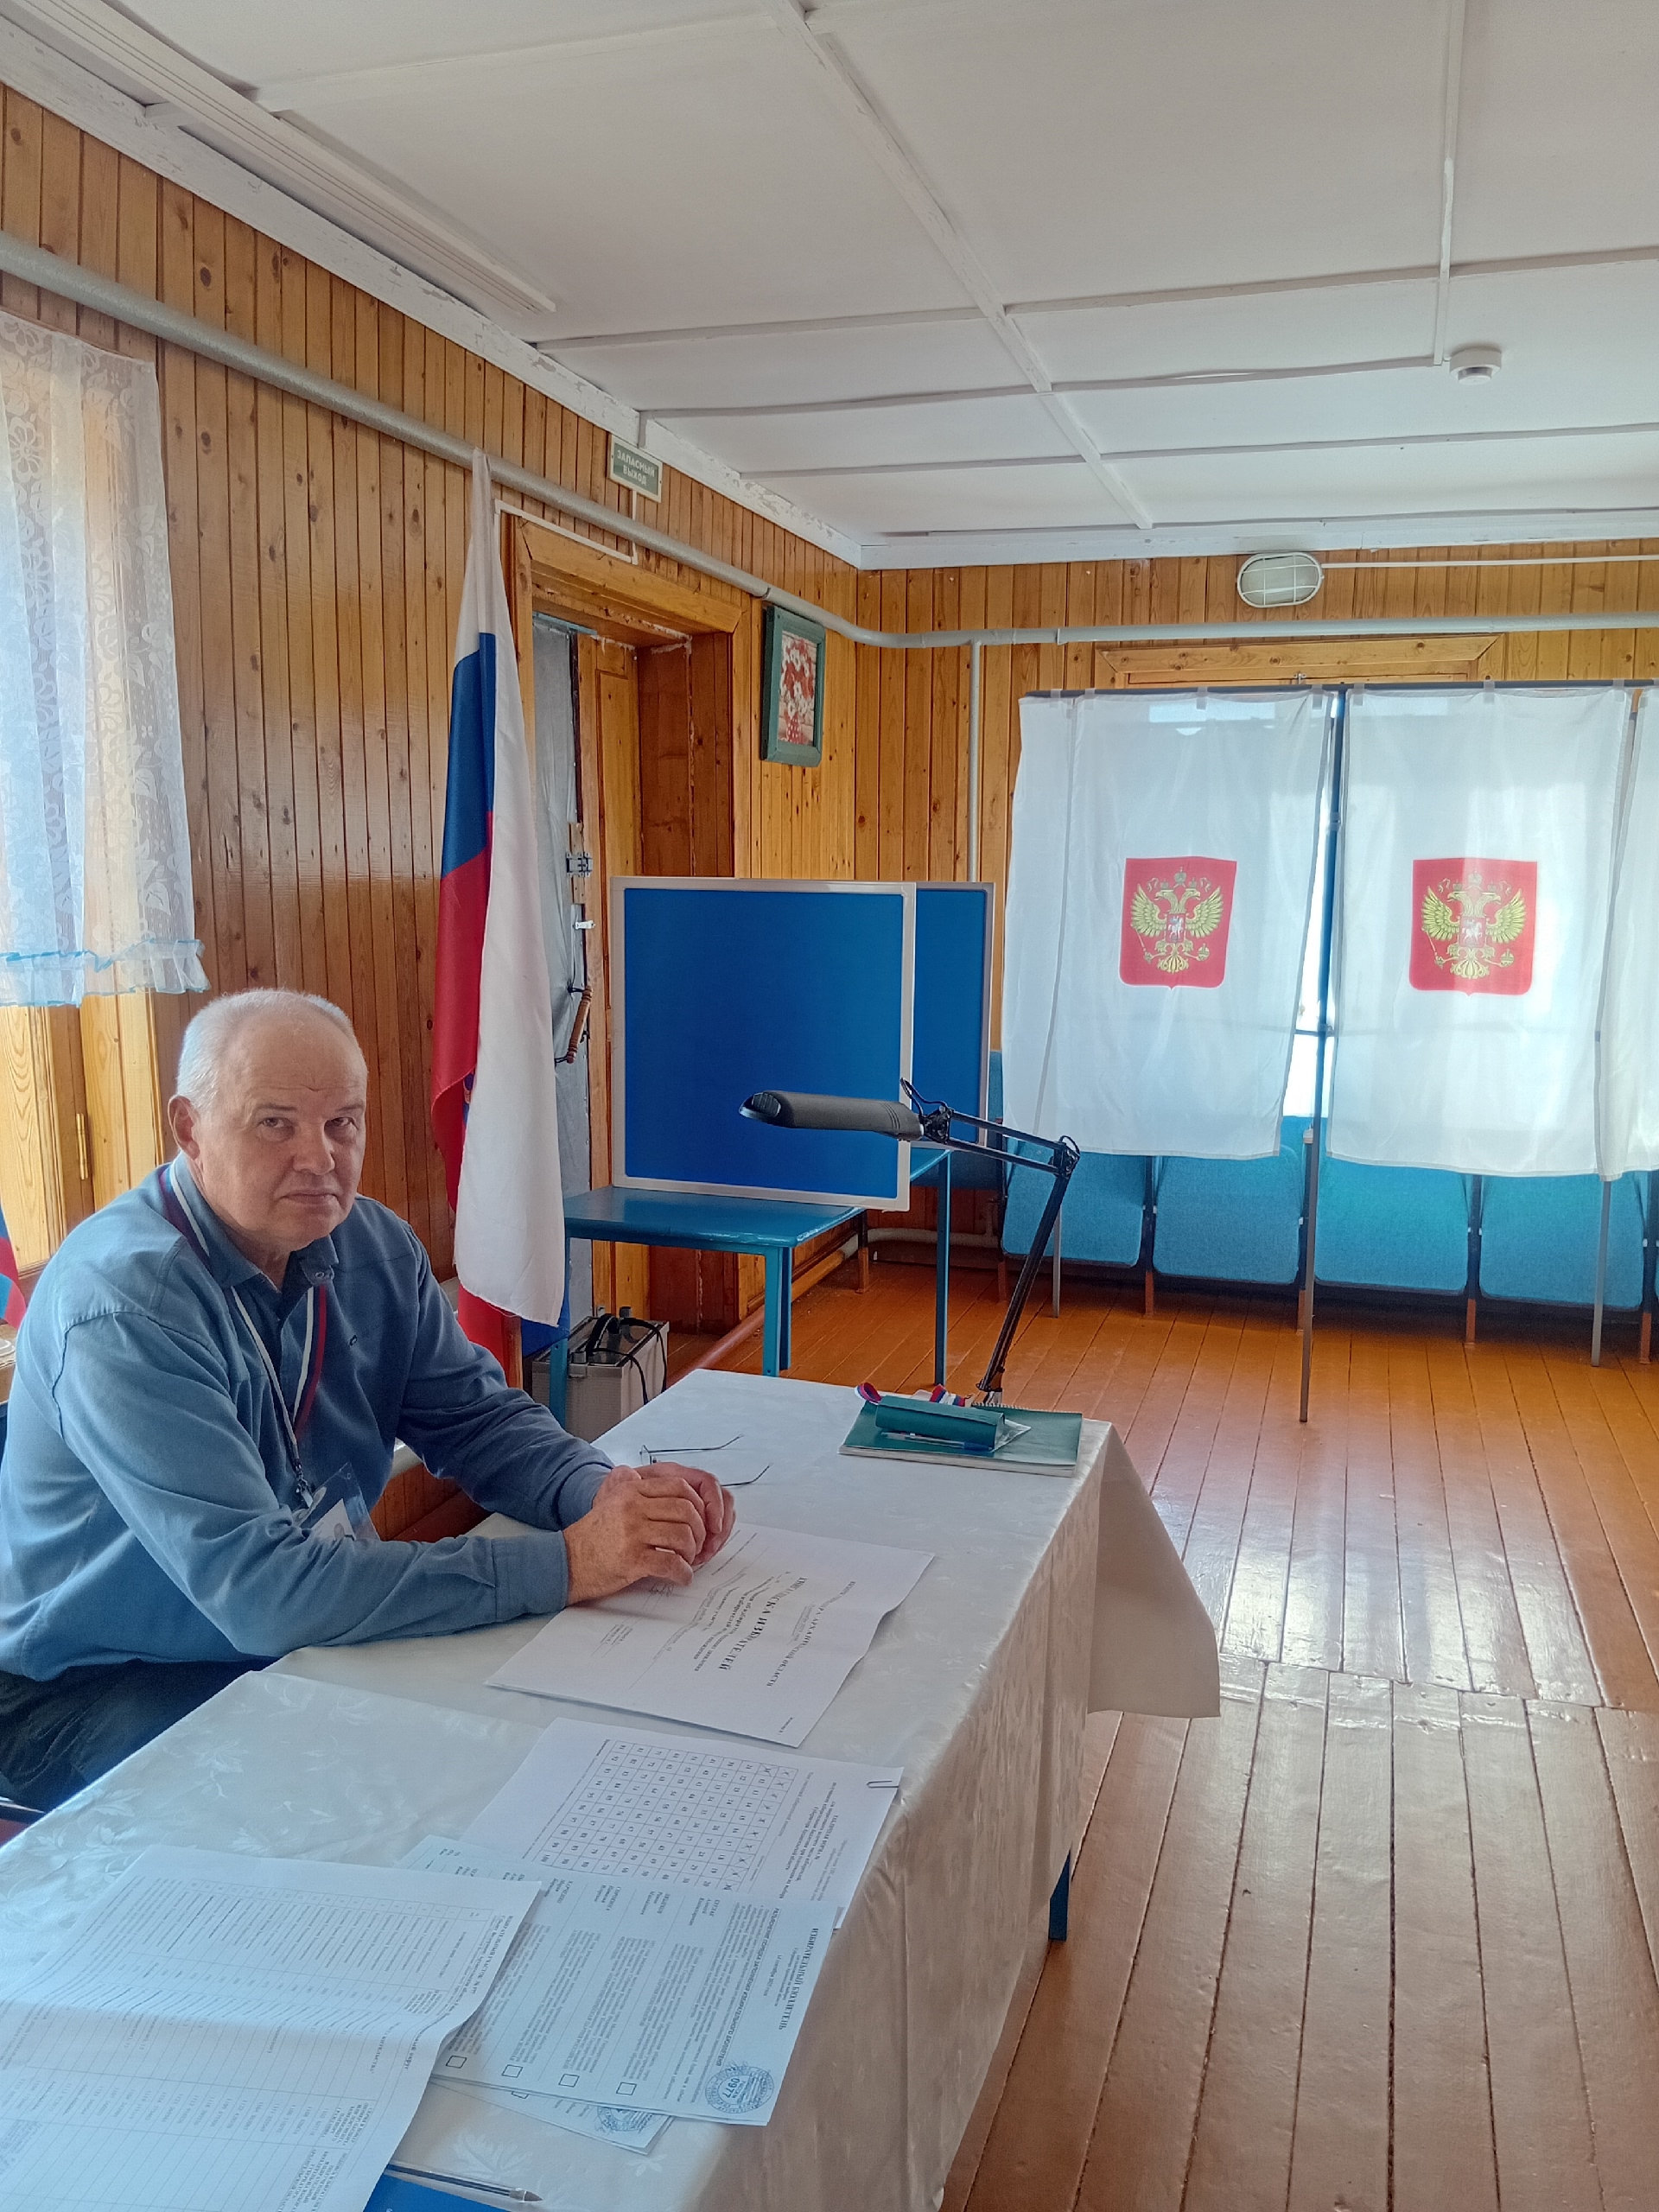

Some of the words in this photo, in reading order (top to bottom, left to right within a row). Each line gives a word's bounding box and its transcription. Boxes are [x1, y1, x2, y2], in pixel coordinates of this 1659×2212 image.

[617, 449, 655, 477] ЗАПАСНЫЙ
[623, 464, 647, 486] ВЫХОД
[792, 1927, 819, 1986] ИЗБИРАТЕЛЬНЫЙ
[777, 1986, 800, 2031] БЮЛЛЕТЕНЬ
[720, 2076, 741, 2098] 0977
